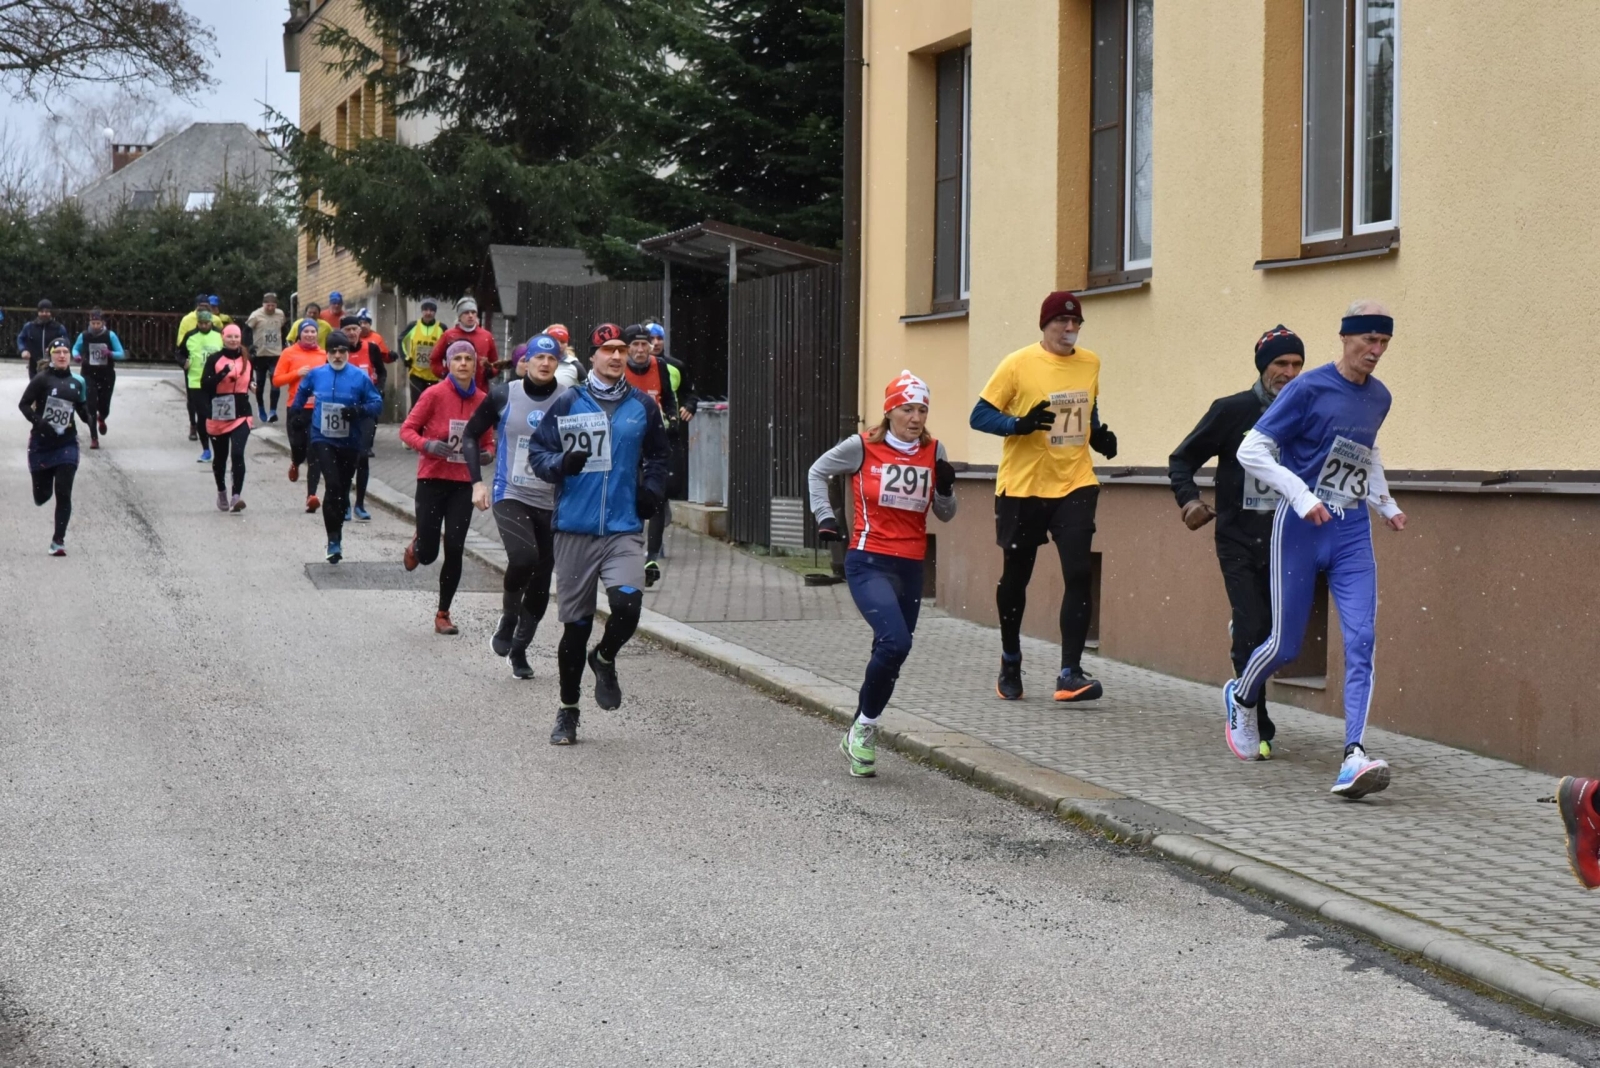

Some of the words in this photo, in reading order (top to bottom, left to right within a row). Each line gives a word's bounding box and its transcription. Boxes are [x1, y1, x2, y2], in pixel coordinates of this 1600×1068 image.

[264, 333, 279, 344] 105
[45, 407, 69, 426] 288
[217, 403, 231, 416] 72
[1060, 407, 1082, 433] 71
[590, 420, 606, 428] LIGA
[562, 430, 606, 458] 297
[884, 464, 929, 498] 291
[1320, 458, 1367, 497] 273
